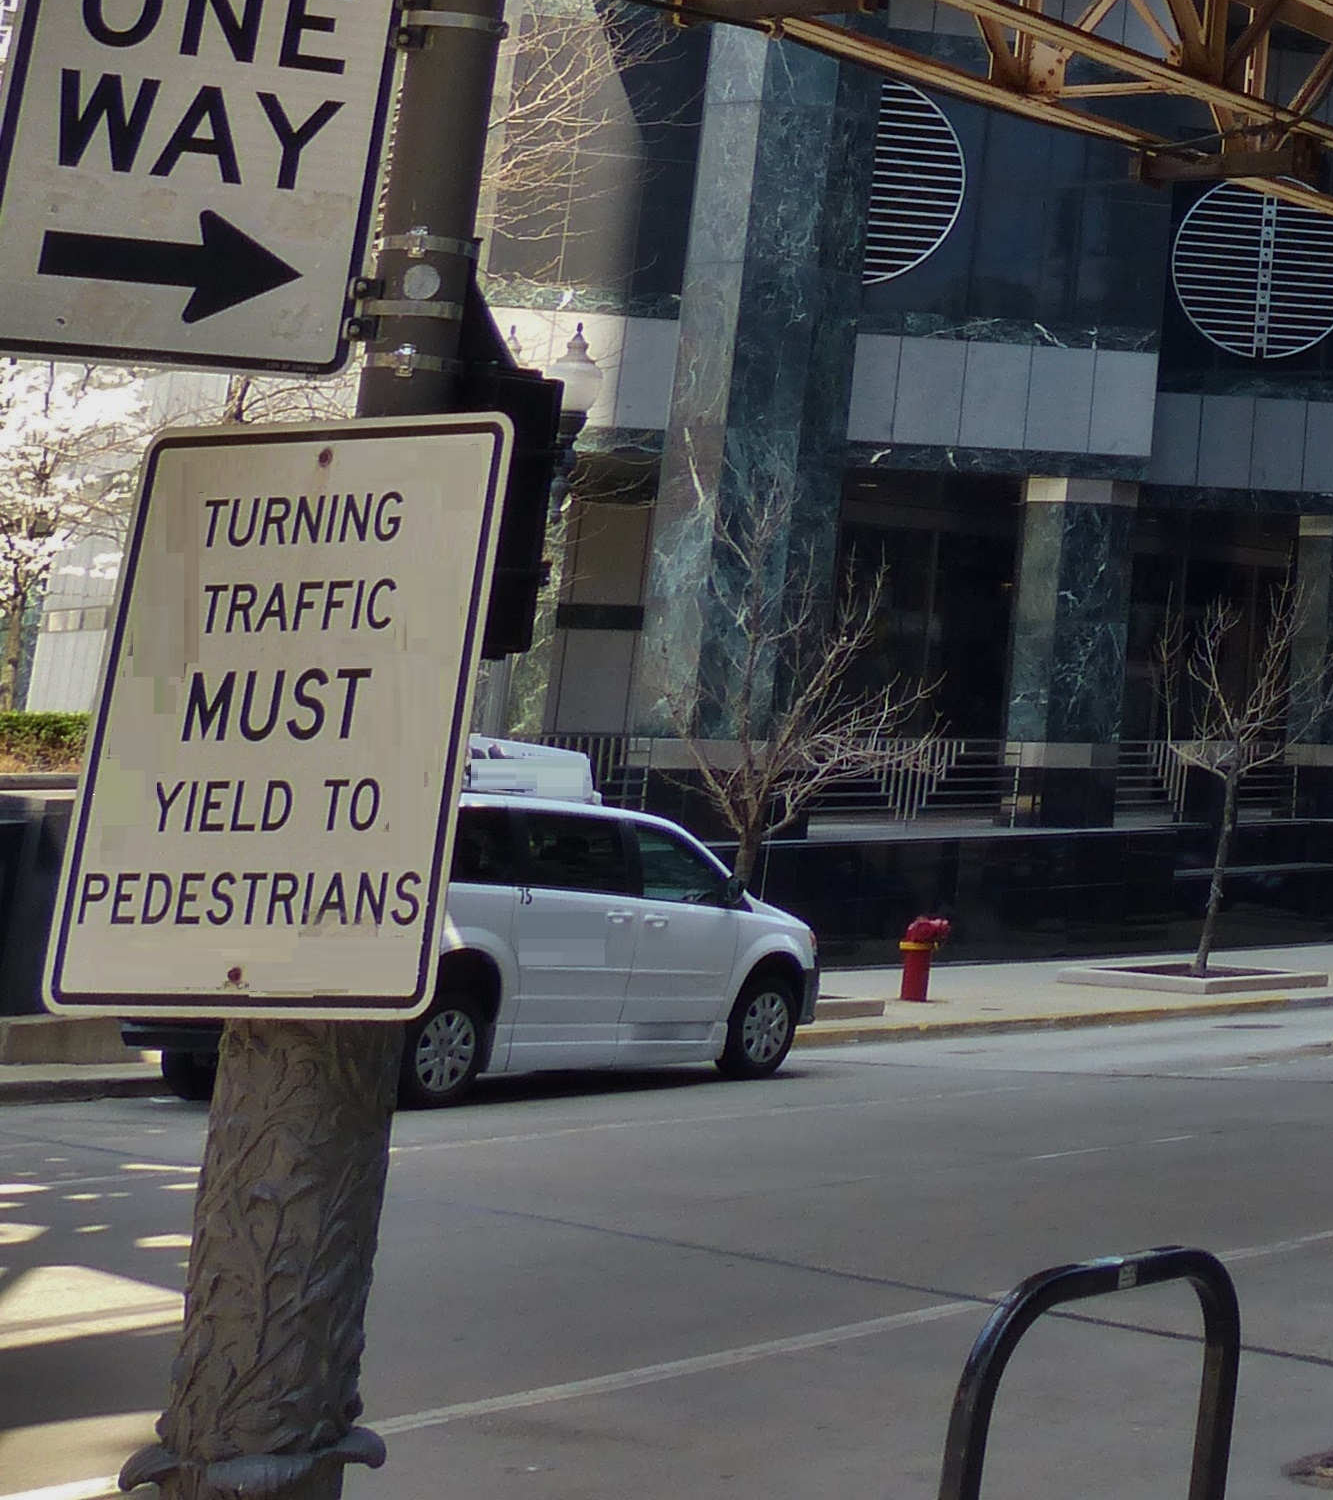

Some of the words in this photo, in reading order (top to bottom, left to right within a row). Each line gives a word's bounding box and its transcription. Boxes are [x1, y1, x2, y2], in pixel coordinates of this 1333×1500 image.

[59, 68, 346, 190] WAY
[204, 491, 404, 548] TURNING
[204, 578, 397, 634] TRAFFIC
[181, 667, 372, 743] MUST
[156, 780, 293, 832] YIELD
[324, 778, 381, 831] TO
[77, 871, 422, 926] PEDESTRIANS
